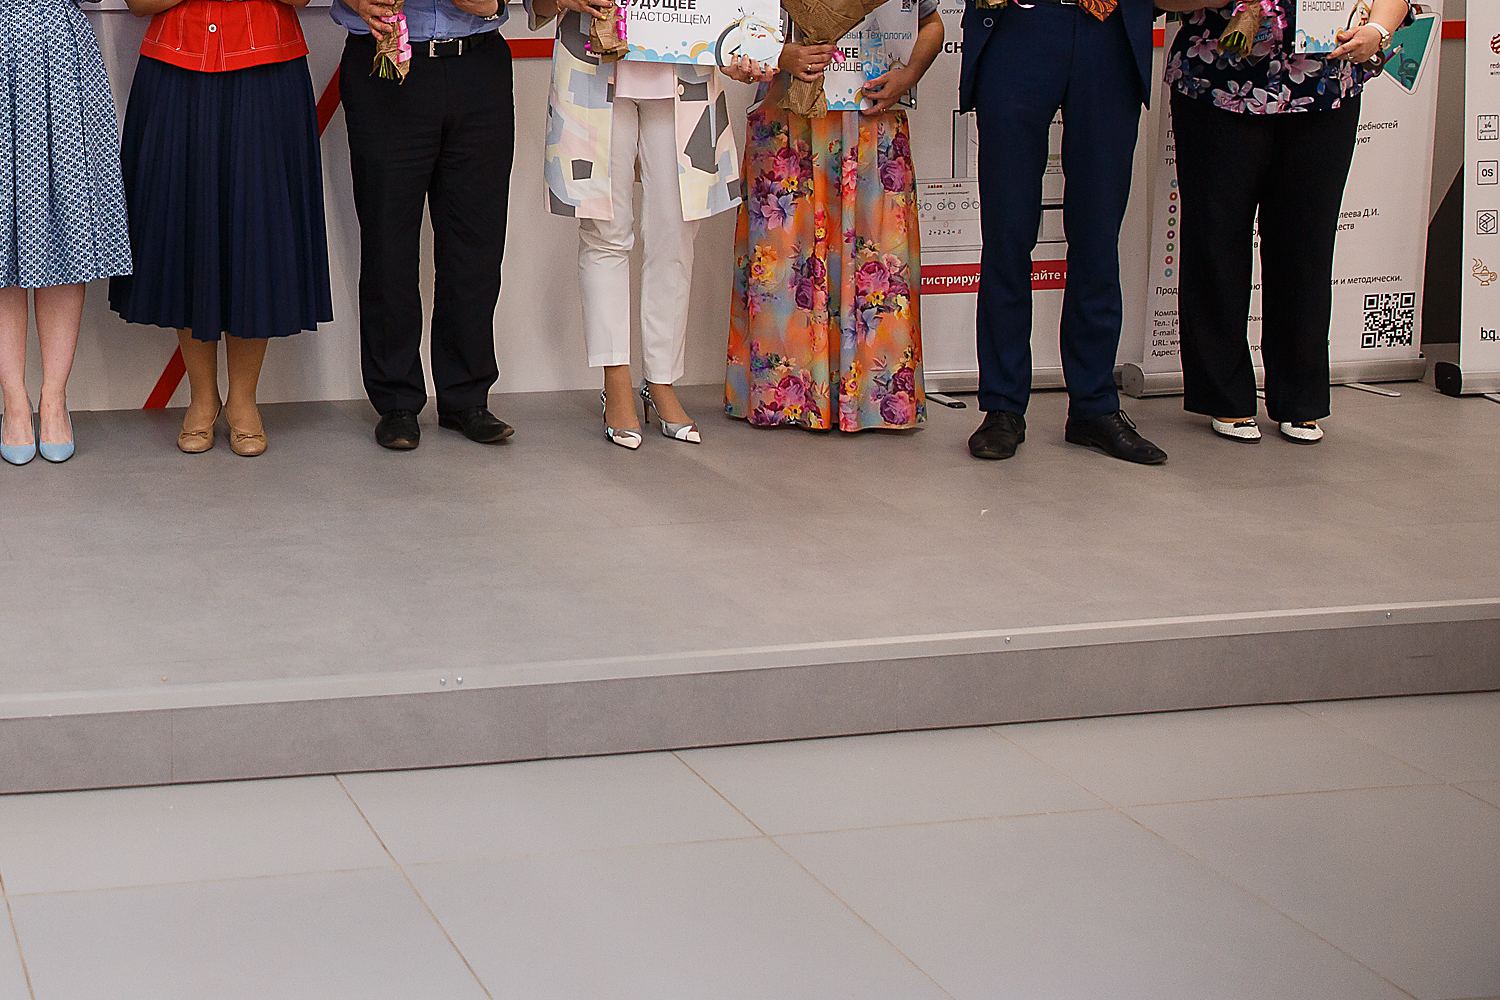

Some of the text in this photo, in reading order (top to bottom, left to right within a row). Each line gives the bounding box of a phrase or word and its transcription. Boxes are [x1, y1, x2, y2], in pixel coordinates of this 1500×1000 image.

[1302, 1, 1345, 12] В НАСТОЯЩЕМ
[630, 10, 711, 25] НАСТОЯЩЕМ
[1481, 168, 1494, 177] OS
[1363, 208, 1380, 217] Д.И.
[1347, 274, 1403, 284] методически.
[1151, 349, 1176, 357] Адрес:
